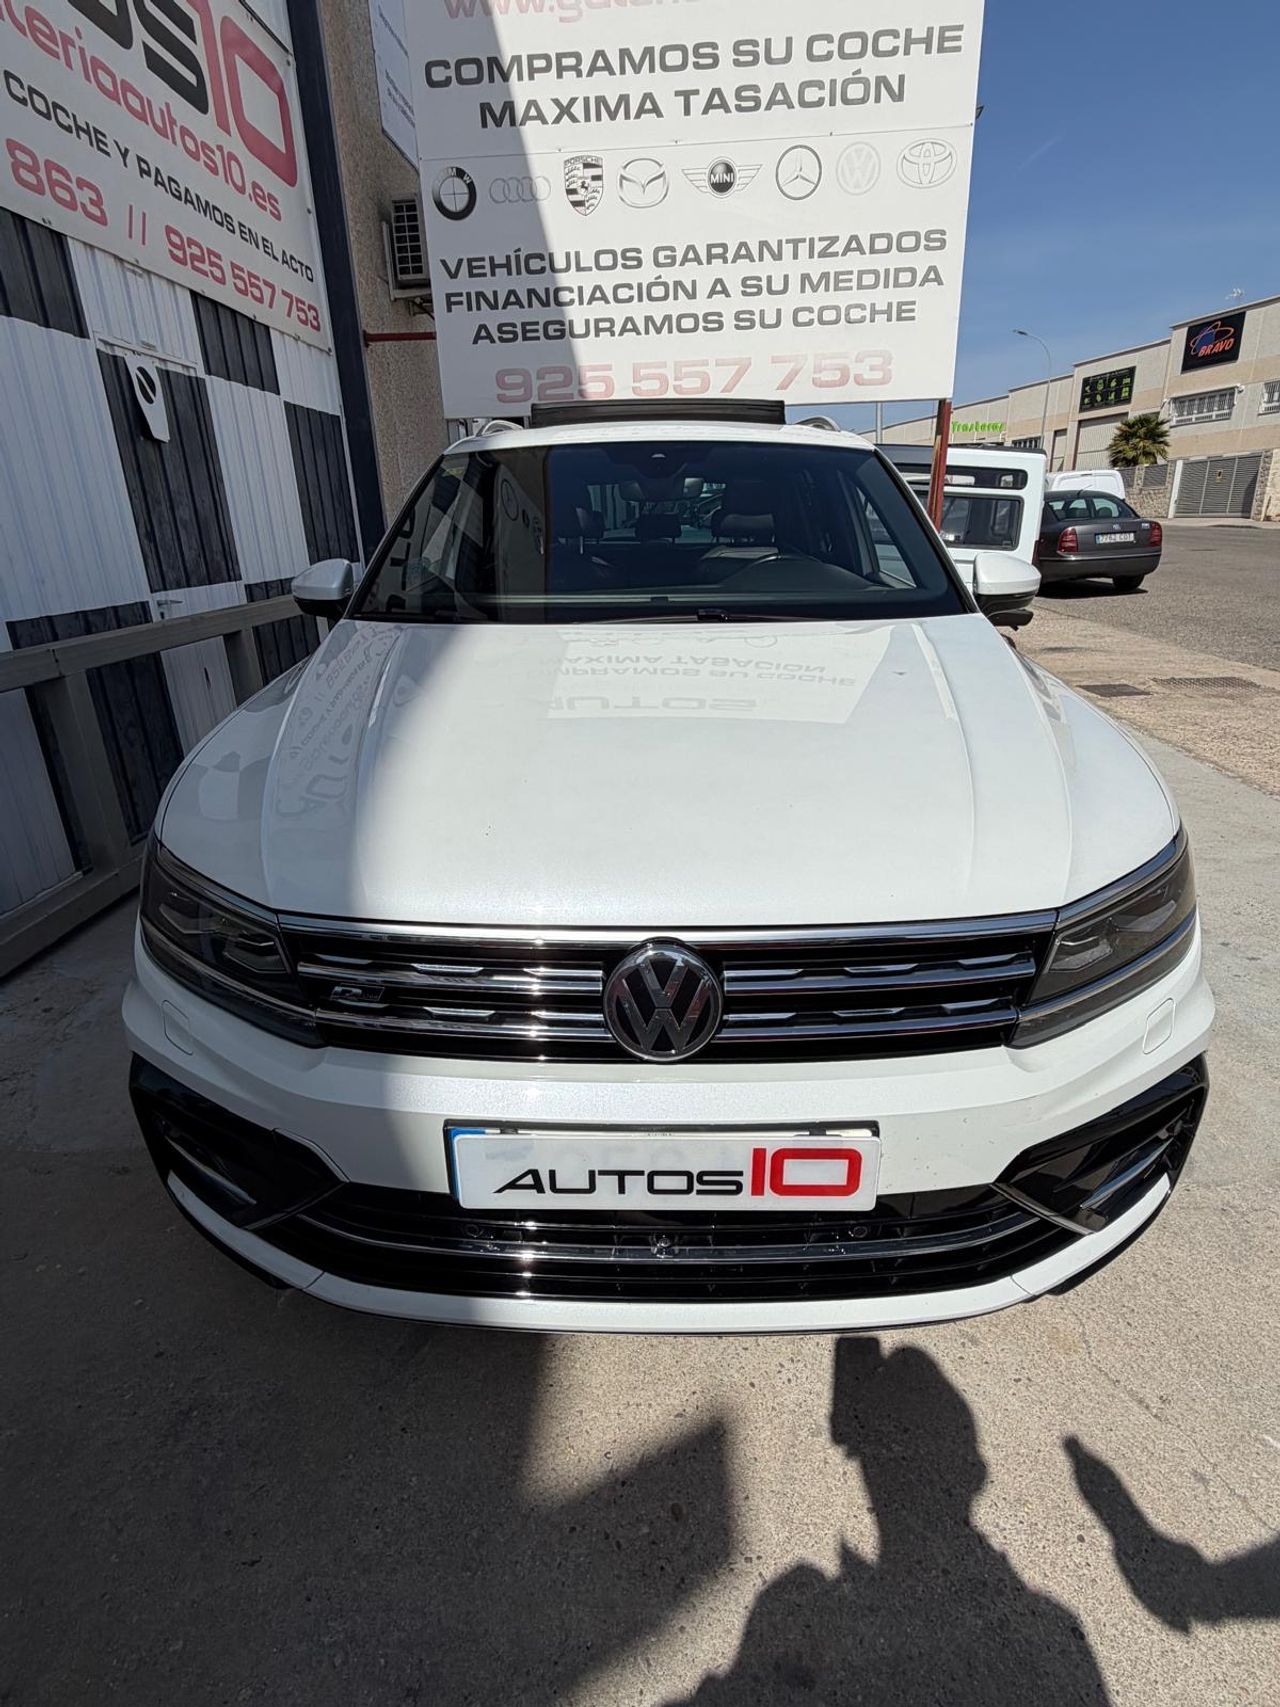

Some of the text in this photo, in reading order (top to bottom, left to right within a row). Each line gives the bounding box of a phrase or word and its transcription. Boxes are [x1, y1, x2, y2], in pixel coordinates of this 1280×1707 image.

[424, 24, 964, 89] COMPRAMOS SU COCHE
[0, 0, 282, 222] leriaautos10.es
[479, 68, 905, 129] MAXIMA TASACIÓN
[3, 69, 314, 283] COCHE Y PAGAMOS EN EL ACTO
[710, 171, 734, 184] MINI
[5, 137, 108, 227] 863
[164, 224, 227, 286] 925
[229, 261, 277, 309] 557
[281, 289, 321, 332] 753
[439, 229, 947, 279] VEHÍCULOS GARANTIZADOS
[445, 265, 944, 313] FINANCIACIÓN A SU MEDIDA
[472, 300, 916, 345] ASEGURAMOS SU COCHE
[1199, 338, 1235, 357] BRAVO
[495, 349, 893, 403] 925 557 753
[493, 1147, 863, 1197] AUTOS10
